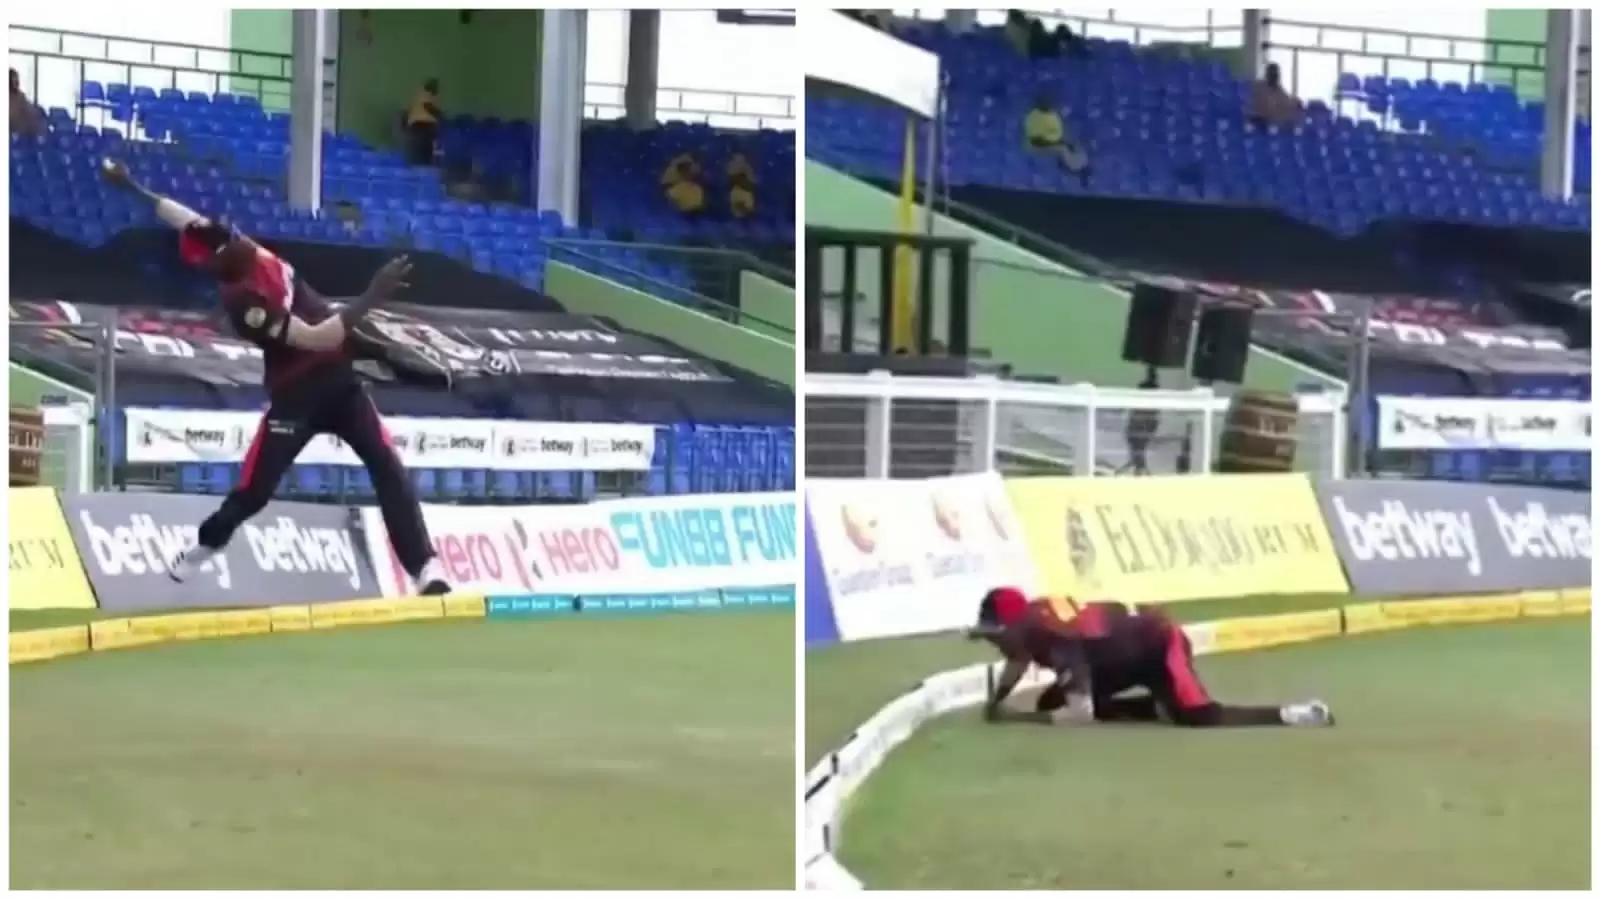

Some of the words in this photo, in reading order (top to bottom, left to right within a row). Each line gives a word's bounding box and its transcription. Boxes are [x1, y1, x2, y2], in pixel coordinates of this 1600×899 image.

[244, 515, 360, 591] betway
[539, 527, 619, 578] Hero
[732, 504, 796, 562] FUN
[1333, 496, 1481, 576] betway
[1487, 496, 1592, 558] betwa
